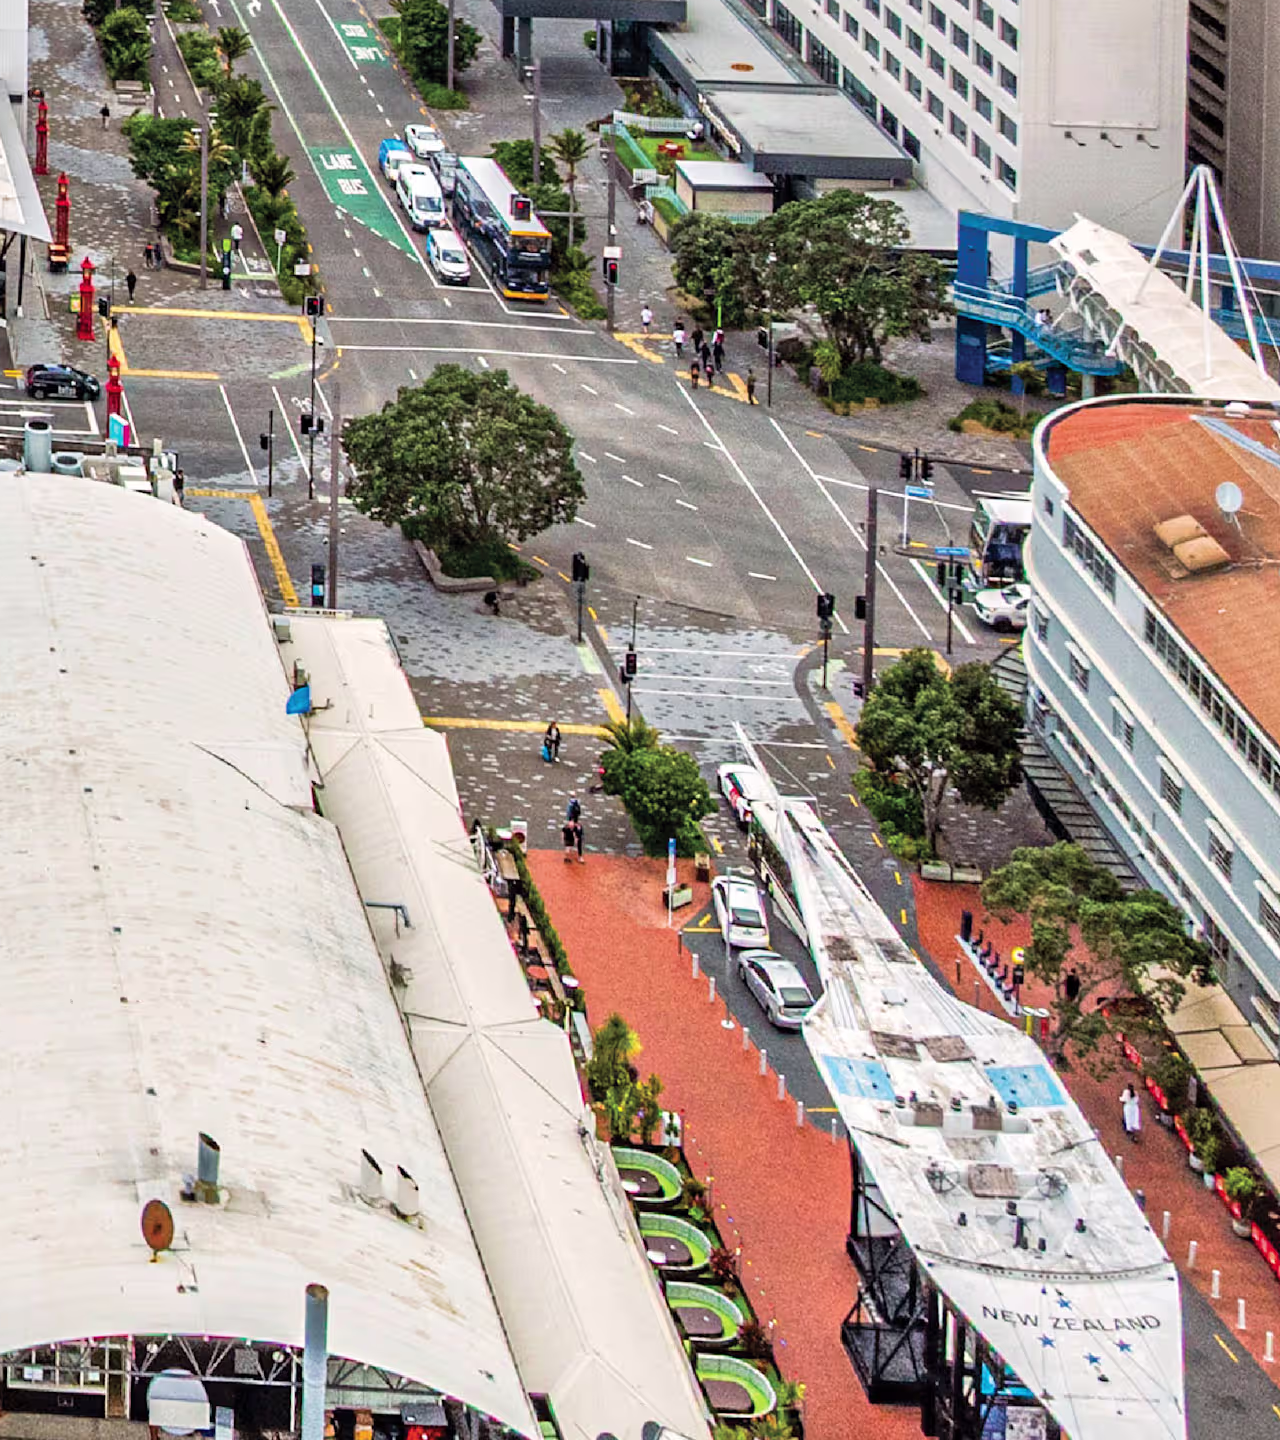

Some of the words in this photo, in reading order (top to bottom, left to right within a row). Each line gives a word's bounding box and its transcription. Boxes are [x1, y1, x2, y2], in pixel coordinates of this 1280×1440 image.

[319, 153, 358, 170] LANE
[336, 178, 369, 195] BUS
[982, 1305, 1038, 1328] NEW
[1048, 1314, 1162, 1332] ZEALAND
